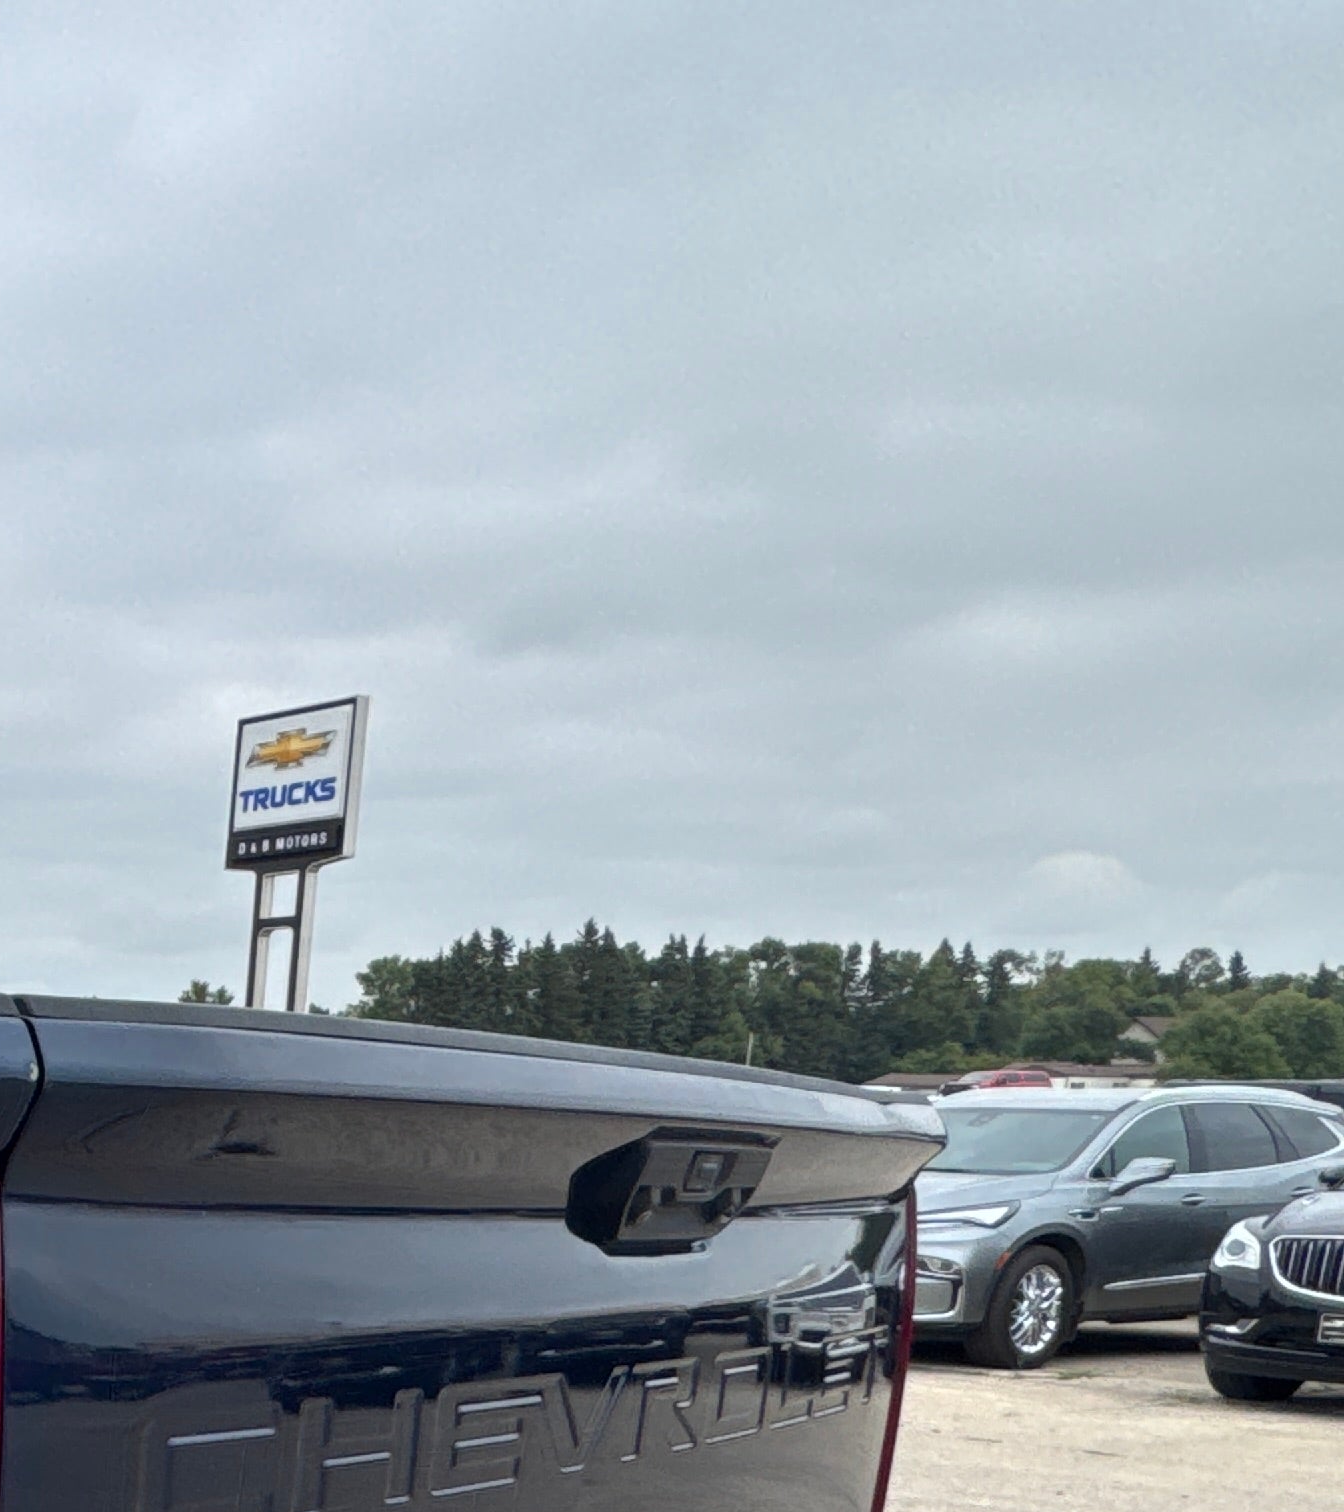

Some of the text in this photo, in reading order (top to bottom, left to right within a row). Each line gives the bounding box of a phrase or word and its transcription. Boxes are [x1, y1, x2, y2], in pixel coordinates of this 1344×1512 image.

[239, 776, 337, 813] TRUCKS
[238, 831, 328, 855] D & B MOTORS
